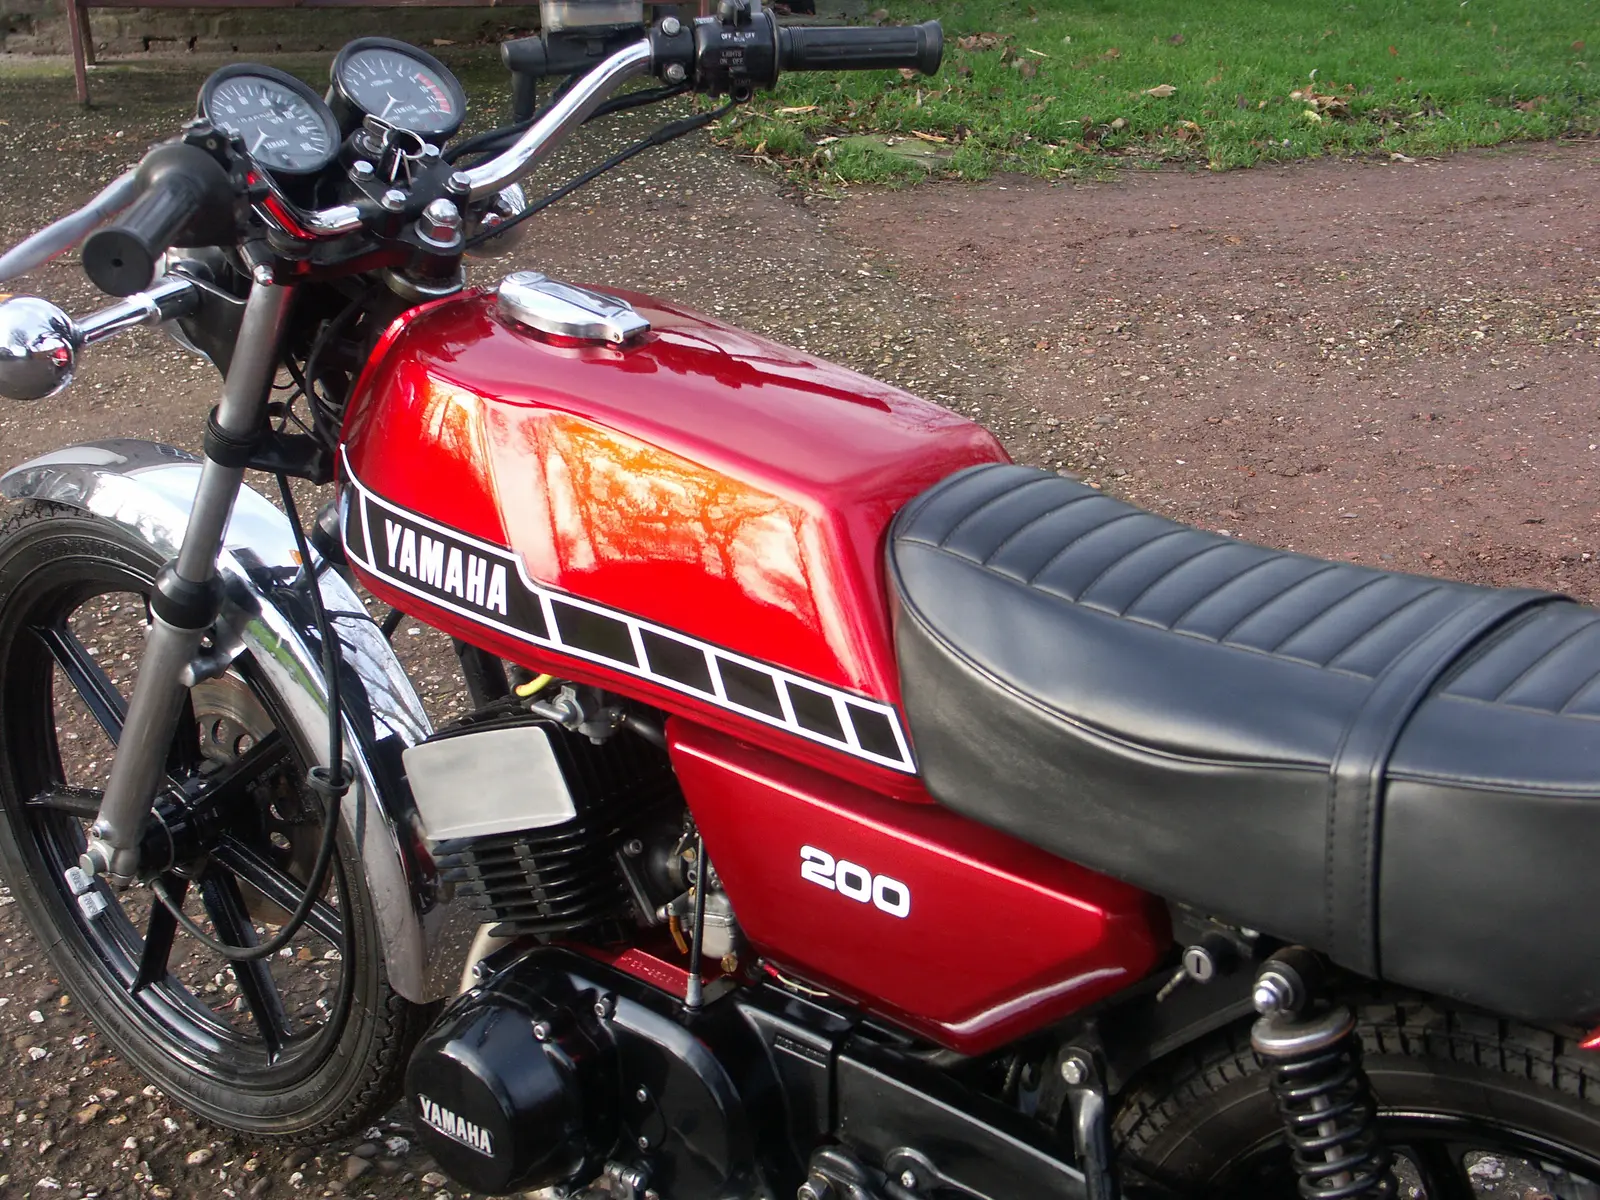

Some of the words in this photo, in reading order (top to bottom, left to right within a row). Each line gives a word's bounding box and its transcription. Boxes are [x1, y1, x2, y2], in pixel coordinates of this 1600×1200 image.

[385, 518, 507, 616] YAMAHA
[800, 844, 911, 918] 200
[420, 1096, 492, 1153] YAMAHA
